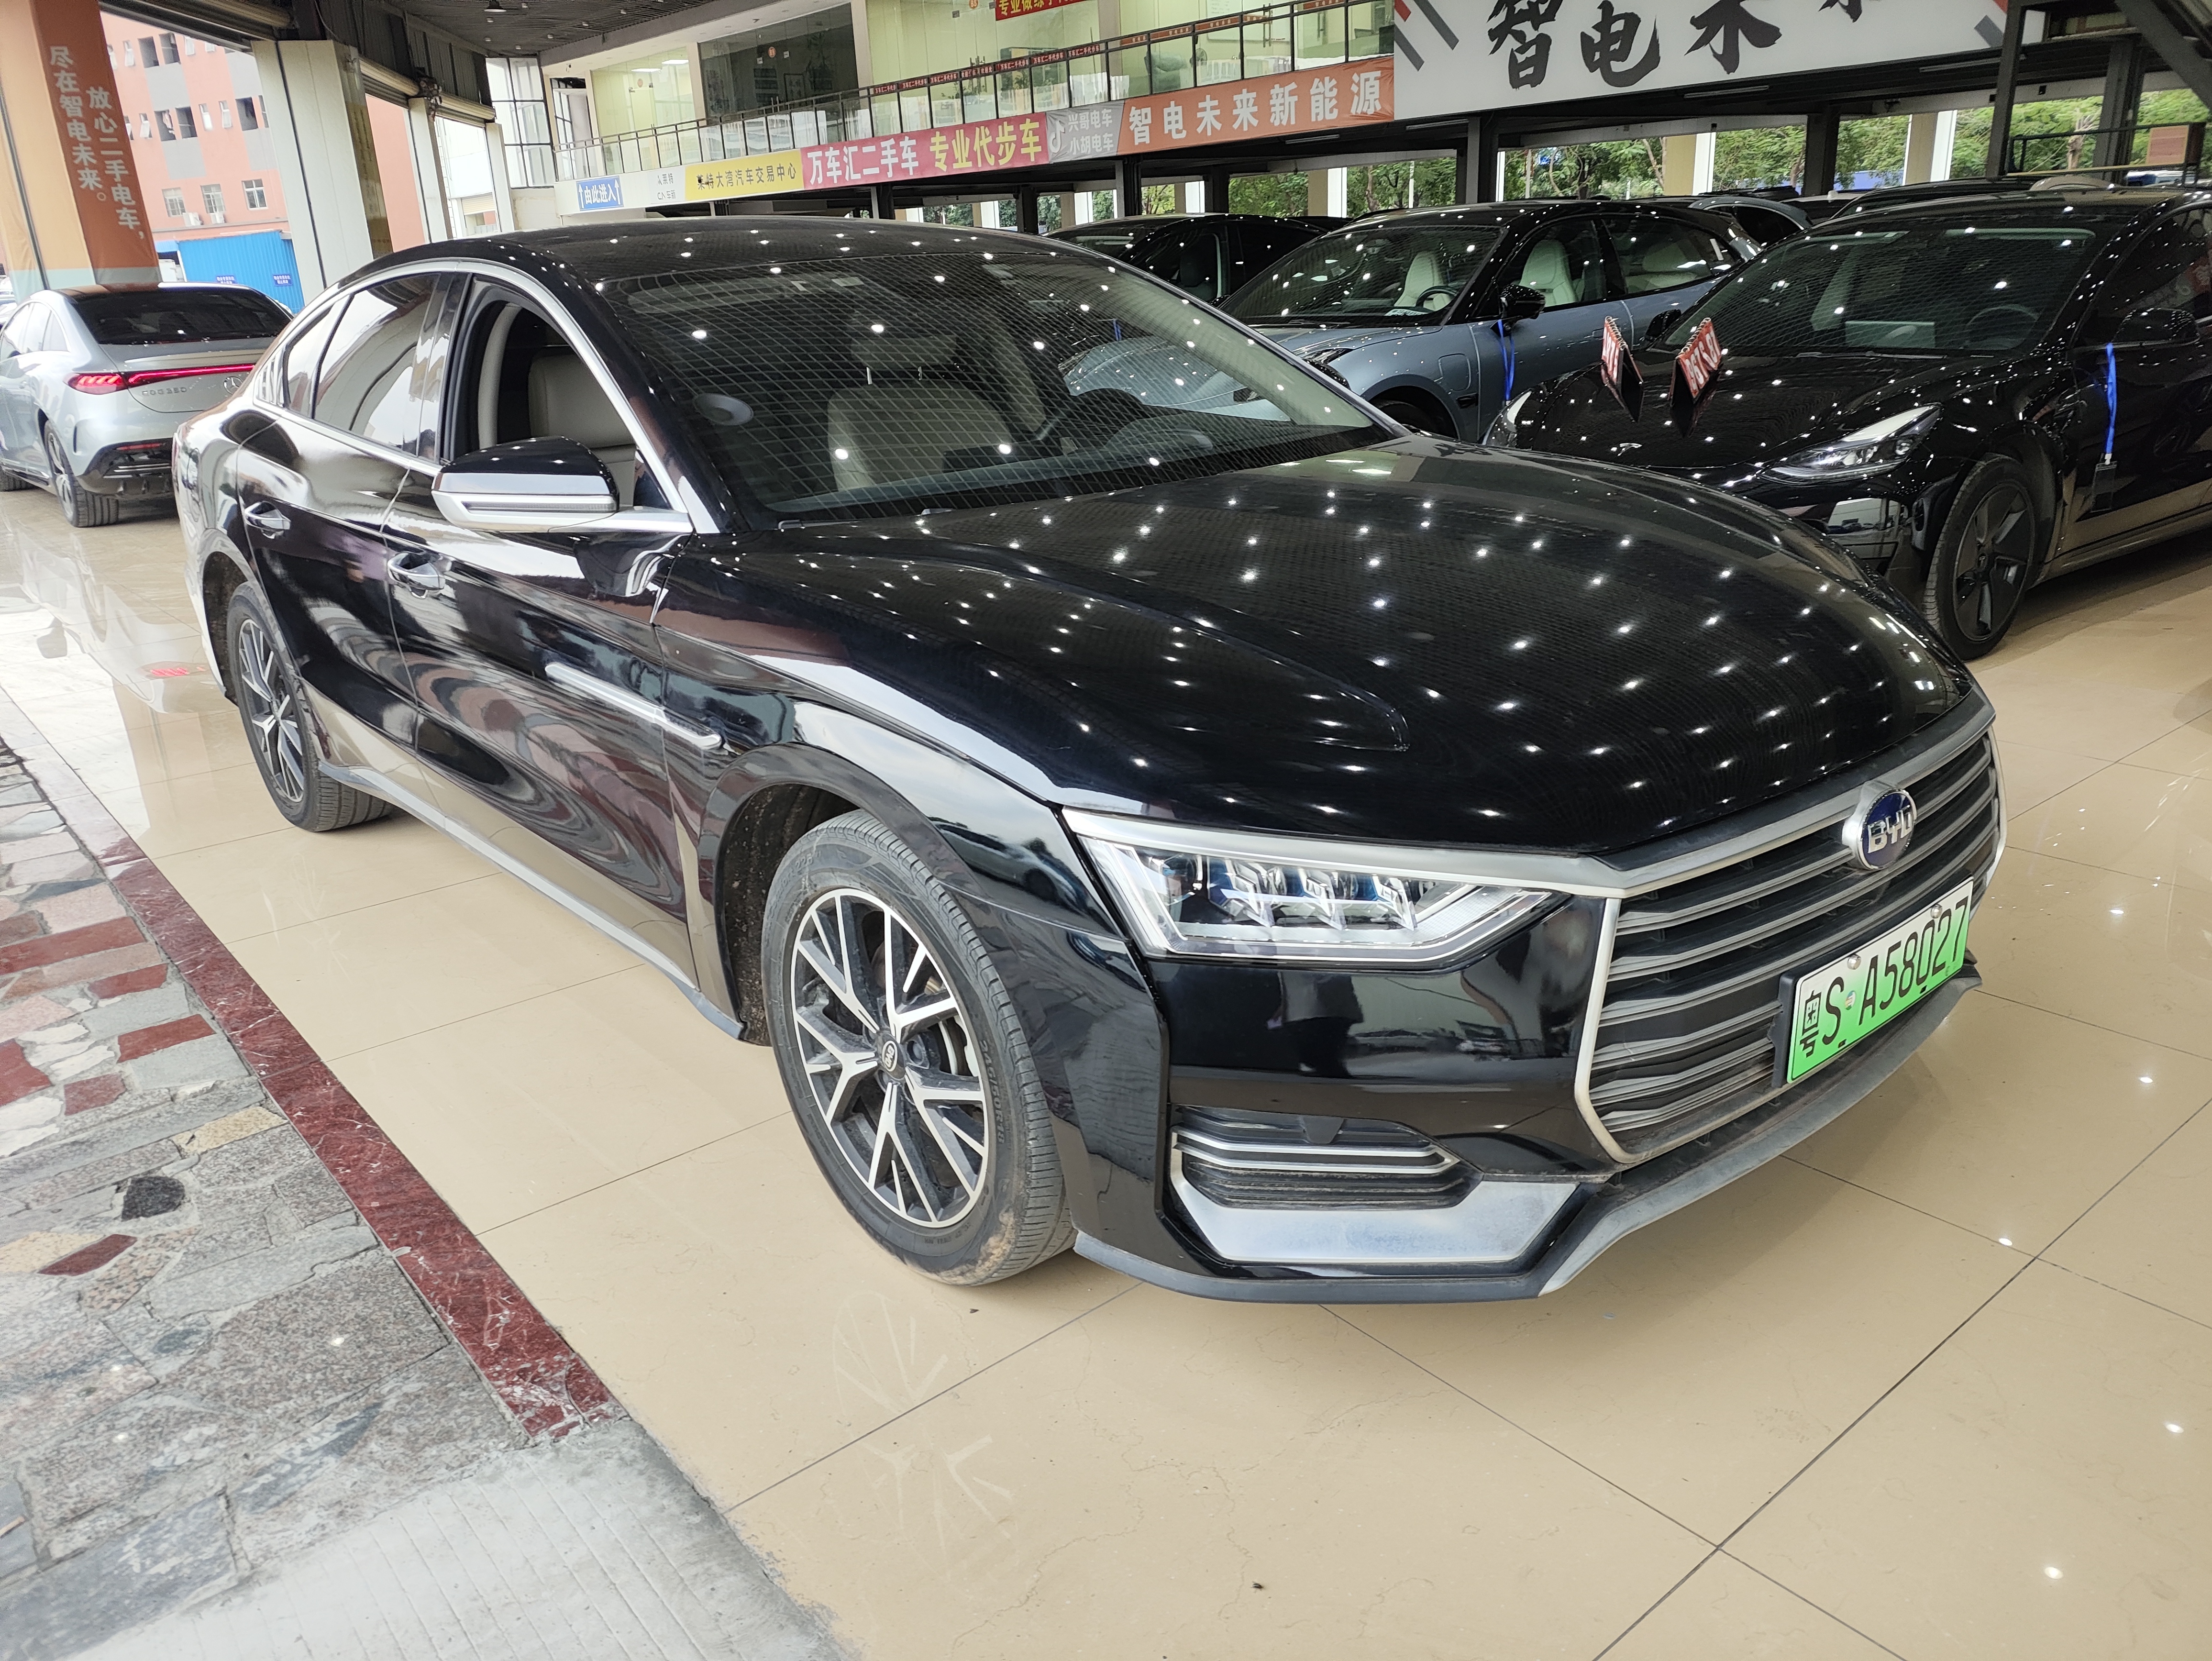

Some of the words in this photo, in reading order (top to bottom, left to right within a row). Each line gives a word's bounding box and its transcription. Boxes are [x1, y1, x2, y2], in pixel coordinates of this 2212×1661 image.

[1068, 109, 1113, 132] 兴哥电车
[1129, 70, 1382, 146] 智电未来新能源
[808, 136, 918, 184] 万车汇二手车
[930, 118, 1042, 172] 专业代步车
[1070, 133, 1114, 155] 小胡电车
[584, 183, 617, 204] 由此进入
[1868, 810, 1913, 853] BYD
